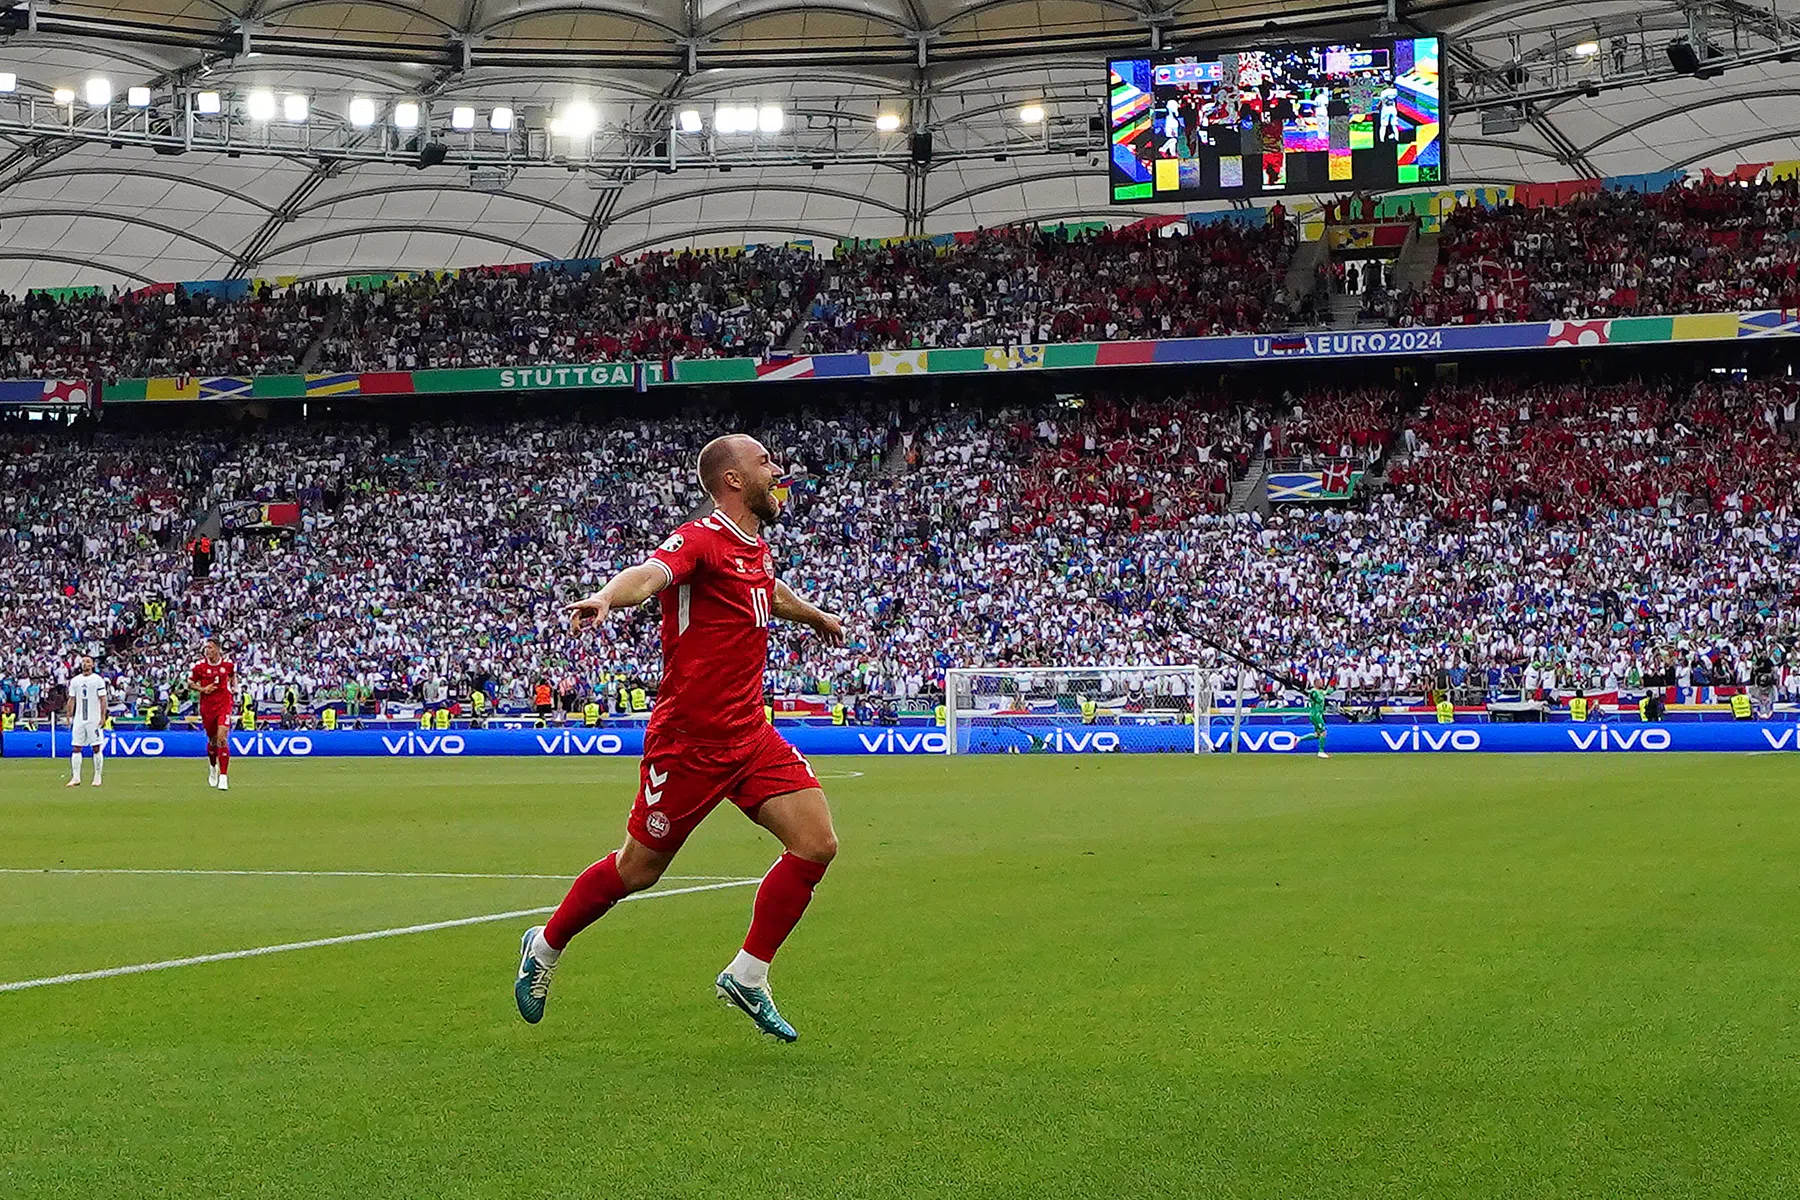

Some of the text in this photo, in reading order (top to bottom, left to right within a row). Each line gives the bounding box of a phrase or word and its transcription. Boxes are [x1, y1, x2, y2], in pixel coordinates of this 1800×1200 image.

[500, 364, 664, 387] STUTTGAT
[750, 588, 768, 627] 10
[232, 733, 313, 755] vivo
[382, 732, 465, 754] vivo
[536, 731, 622, 754] vivo
[858, 728, 947, 752] vivo
[1381, 725, 1481, 750] vivo
[1568, 723, 1671, 750] vivo
